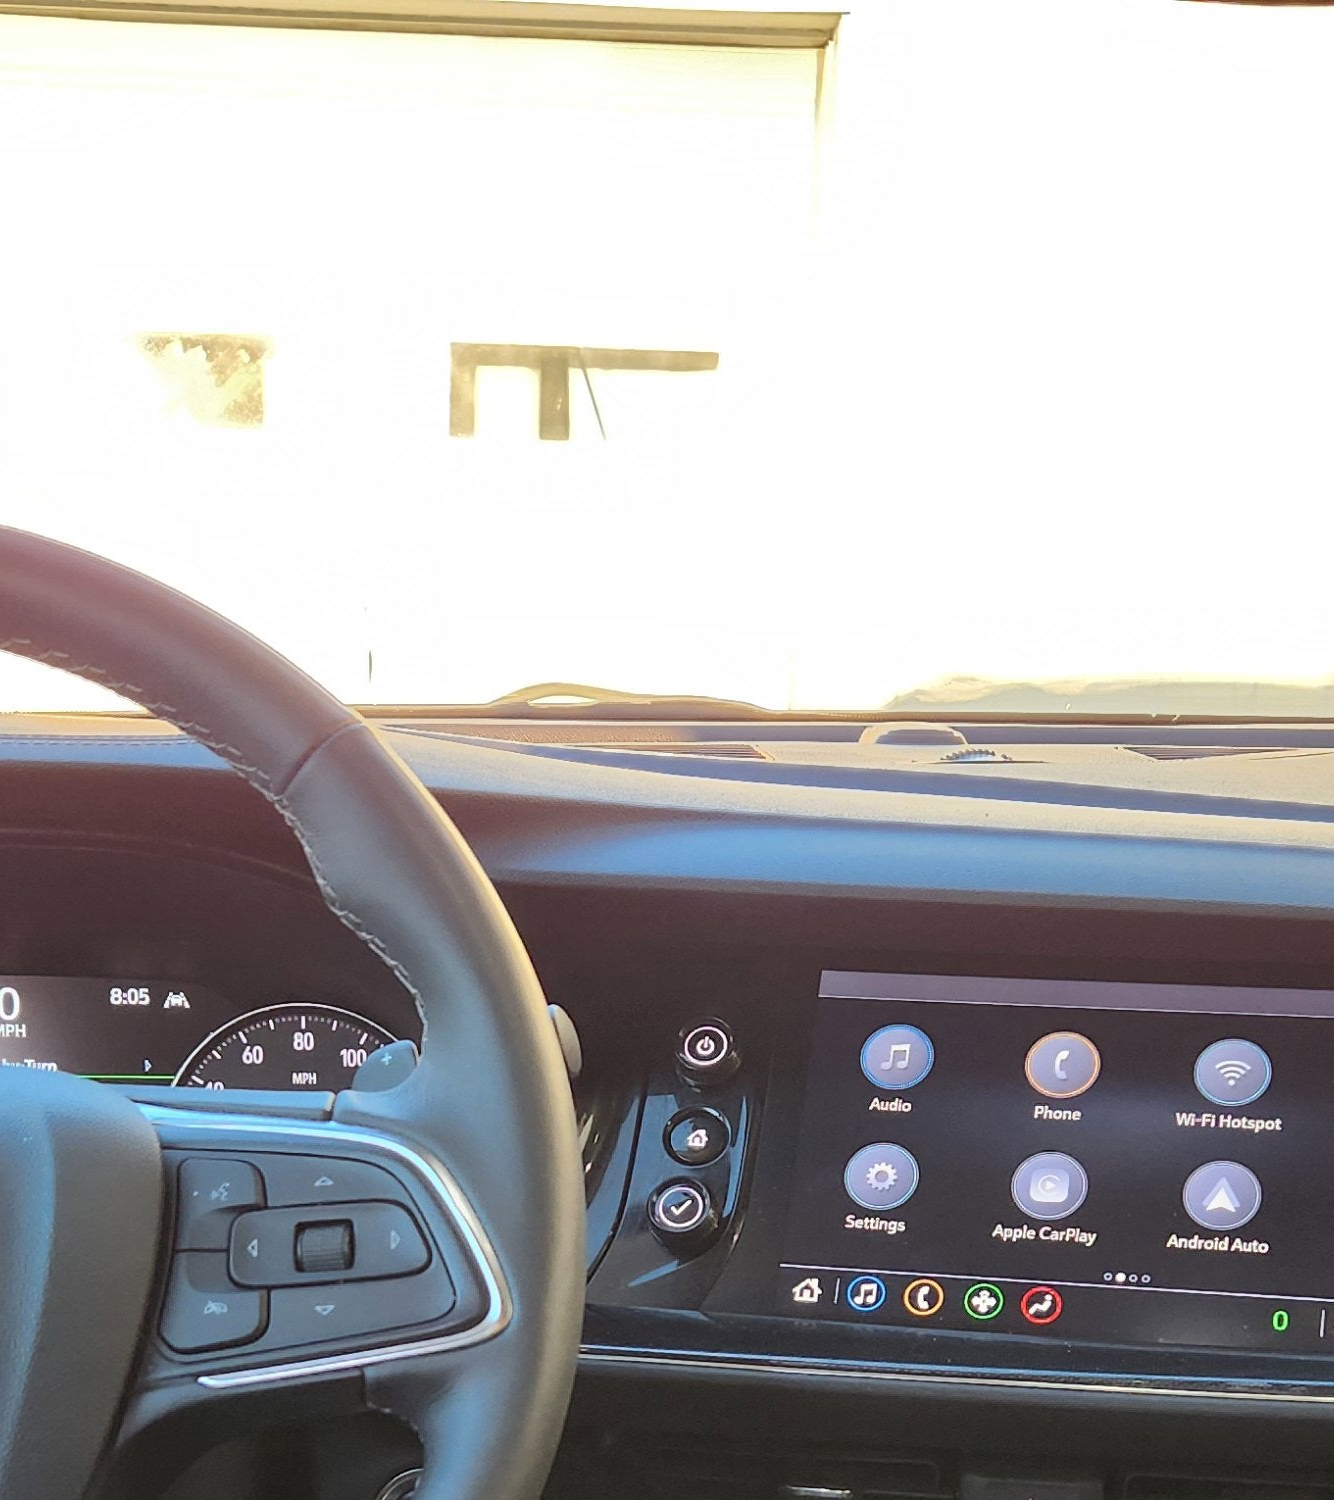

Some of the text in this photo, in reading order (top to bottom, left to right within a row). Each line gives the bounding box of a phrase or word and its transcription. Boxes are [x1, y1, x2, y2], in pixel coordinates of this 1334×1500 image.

[110, 987, 150, 1005] 8:05
[293, 1031, 315, 1051] 80
[241, 1046, 264, 1065] 60
[339, 1049, 368, 1068] 100
[291, 1072, 317, 1085] MPH
[868, 1097, 913, 1113] Audio
[1033, 1105, 1082, 1121] Phone
[1175, 1112, 1283, 1133] Wi-Fi Hotspot
[844, 1215, 906, 1235] Settings
[991, 1223, 1097, 1246] Apple CarPlay
[1166, 1234, 1270, 1254] Android Auto
[1272, 1310, 1289, 1331] 0
